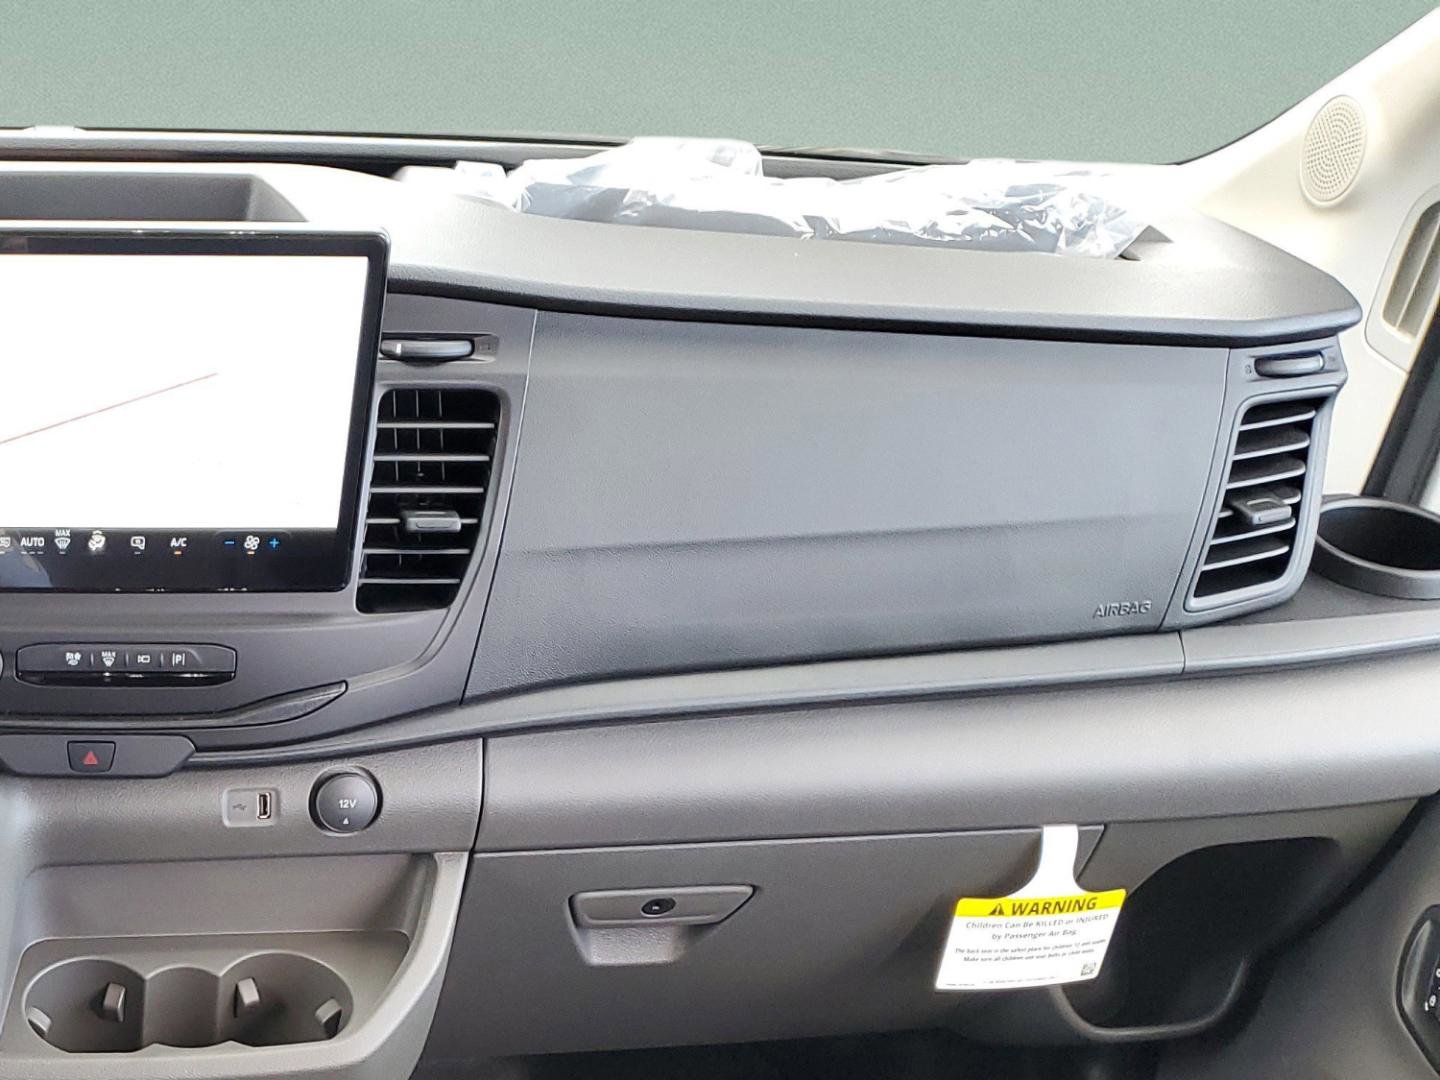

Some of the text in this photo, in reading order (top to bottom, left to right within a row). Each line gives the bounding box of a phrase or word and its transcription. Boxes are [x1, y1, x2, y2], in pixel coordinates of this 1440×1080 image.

[55, 529, 71, 537] MAX
[20, 537, 45, 547] AUTO
[171, 537, 187, 547] A/C
[1092, 600, 1152, 619] AIRBAG
[339, 799, 357, 808] 12V
[1011, 897, 1098, 916] WARNING
[1005, 921, 1021, 929] Can
[992, 933, 1002, 941] by
[1004, 932, 1047, 941] Passenger
